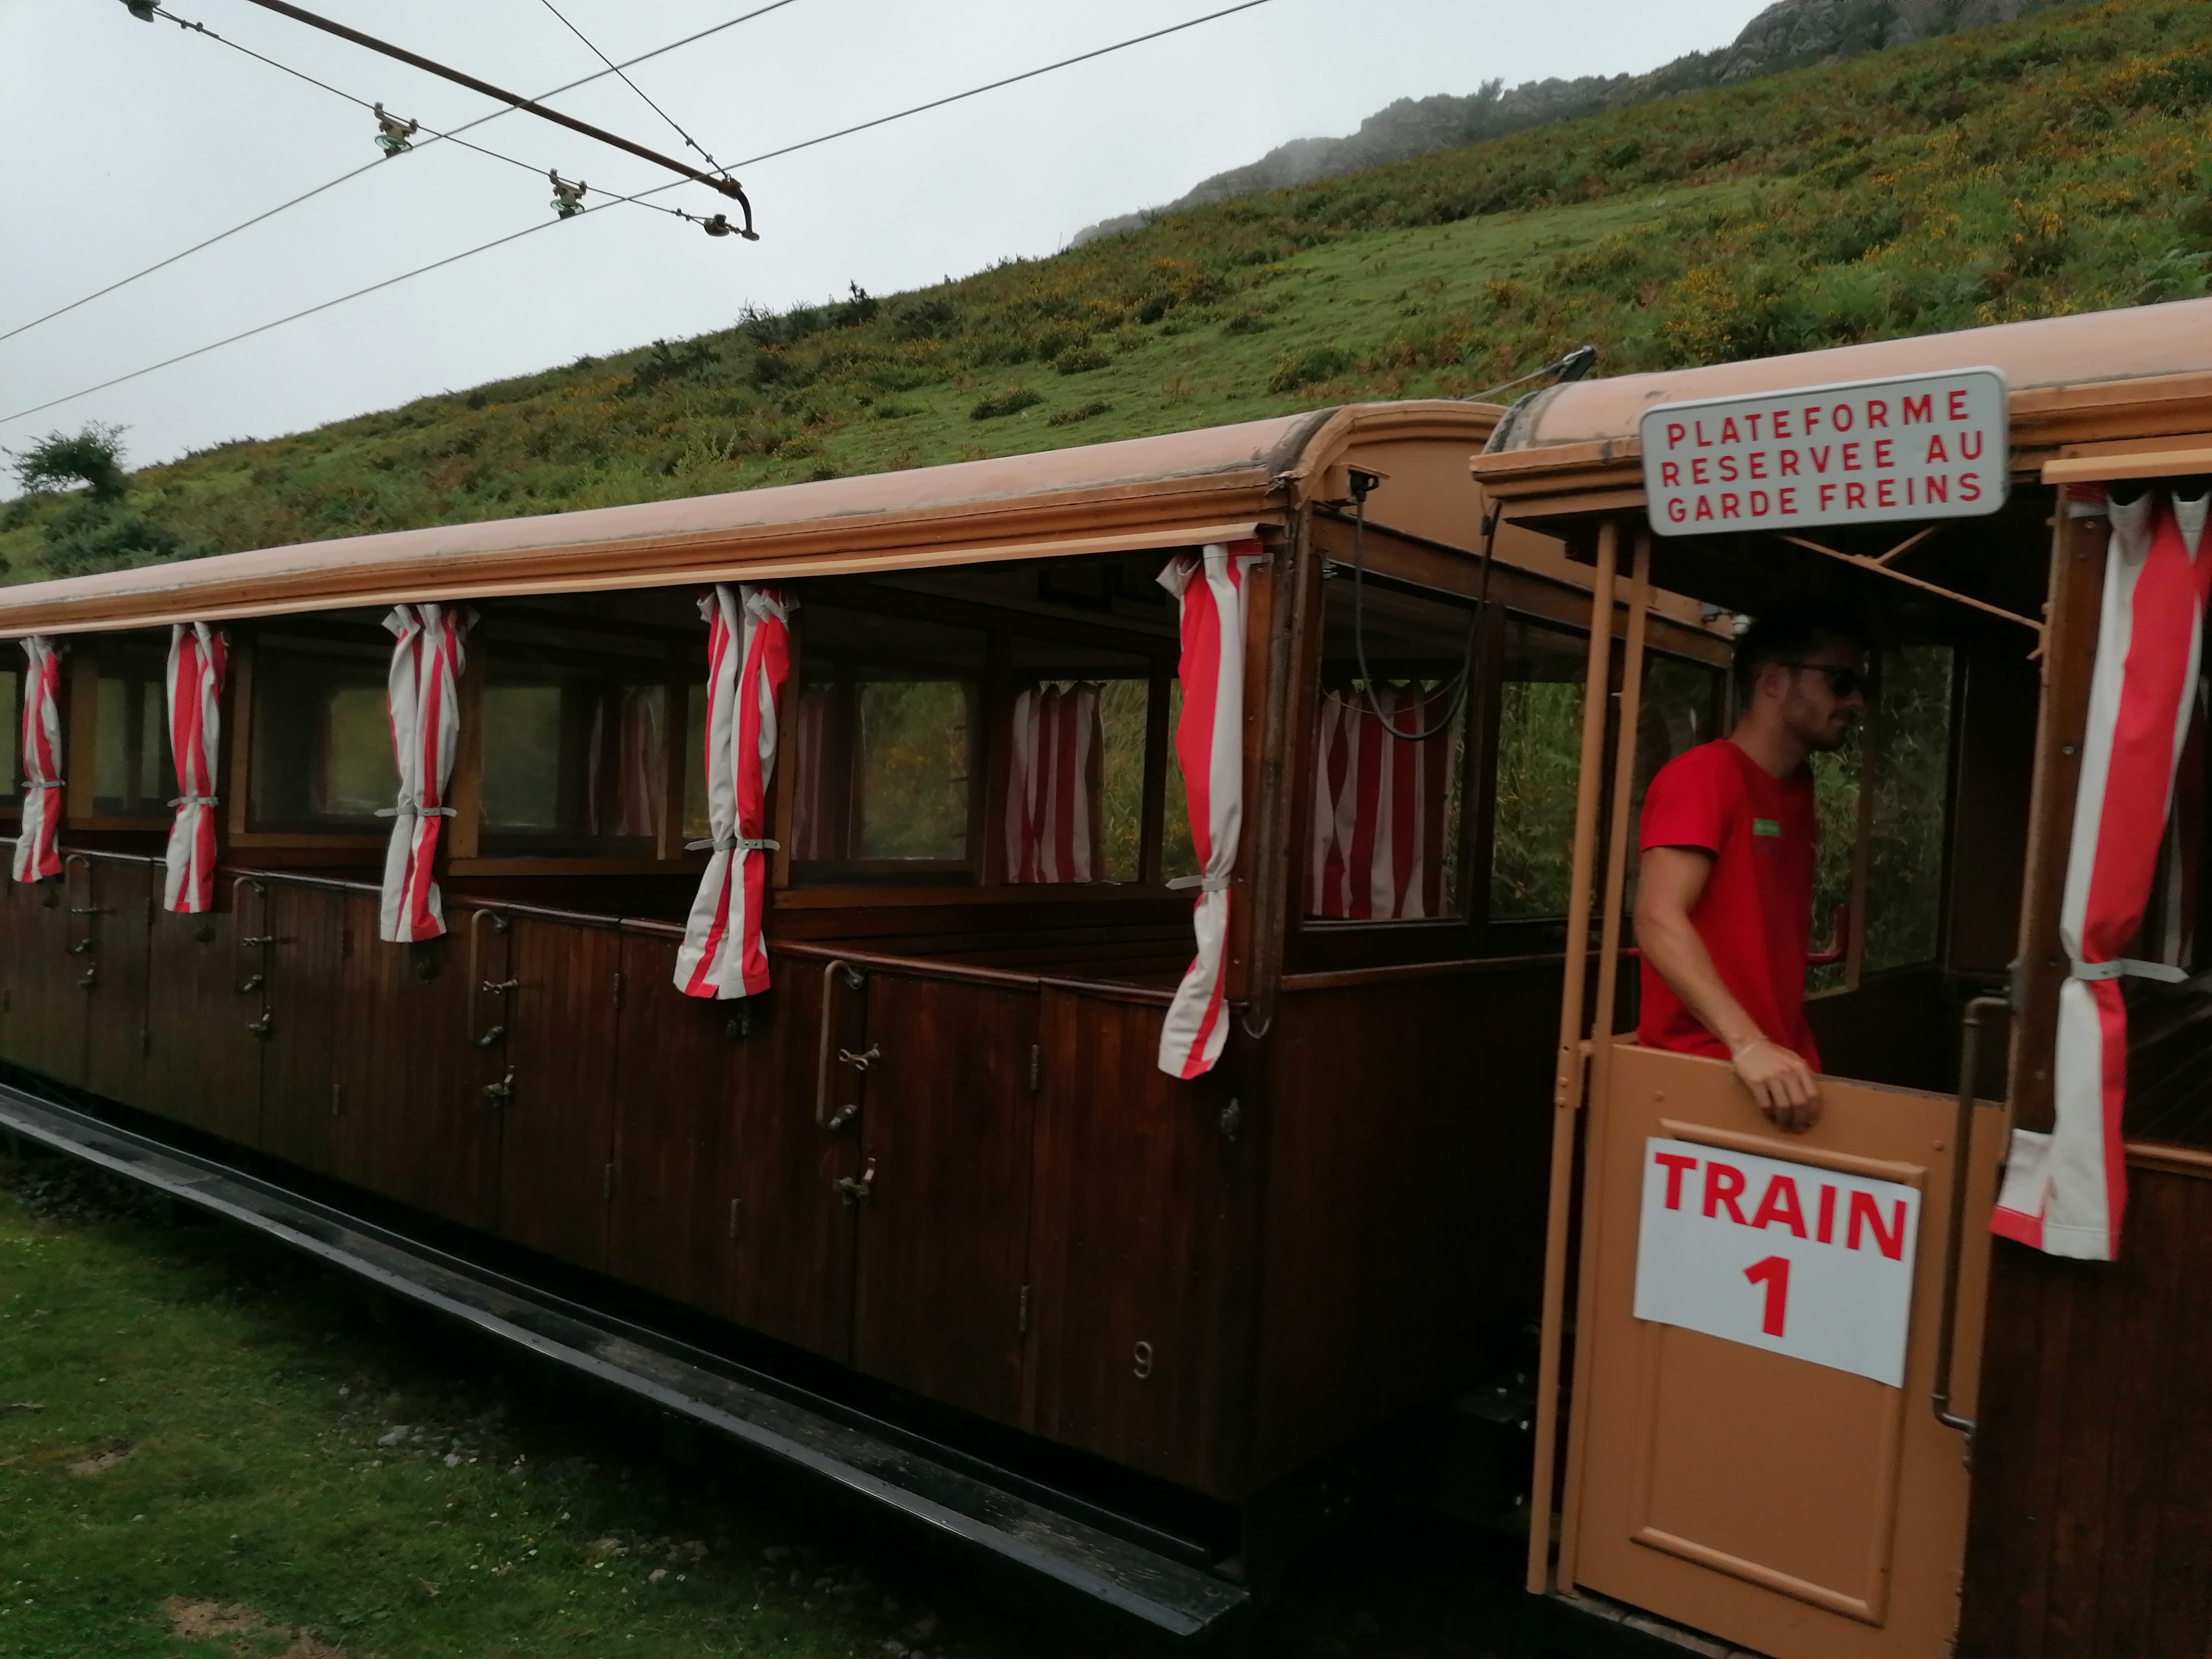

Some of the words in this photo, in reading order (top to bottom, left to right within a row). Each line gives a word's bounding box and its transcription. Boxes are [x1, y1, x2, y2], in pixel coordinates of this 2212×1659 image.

[1667, 390, 1969, 450] PLATEFORME
[1661, 439, 1895, 487] RESERVEE
[1926, 430, 1983, 464] AU
[1668, 487, 1798, 523] GARDE
[1819, 472, 1981, 512] FREINS
[1655, 1152, 1907, 1261] TRAIN
[1743, 1255, 1791, 1338] 1
[1134, 1340, 1153, 1379] 9
